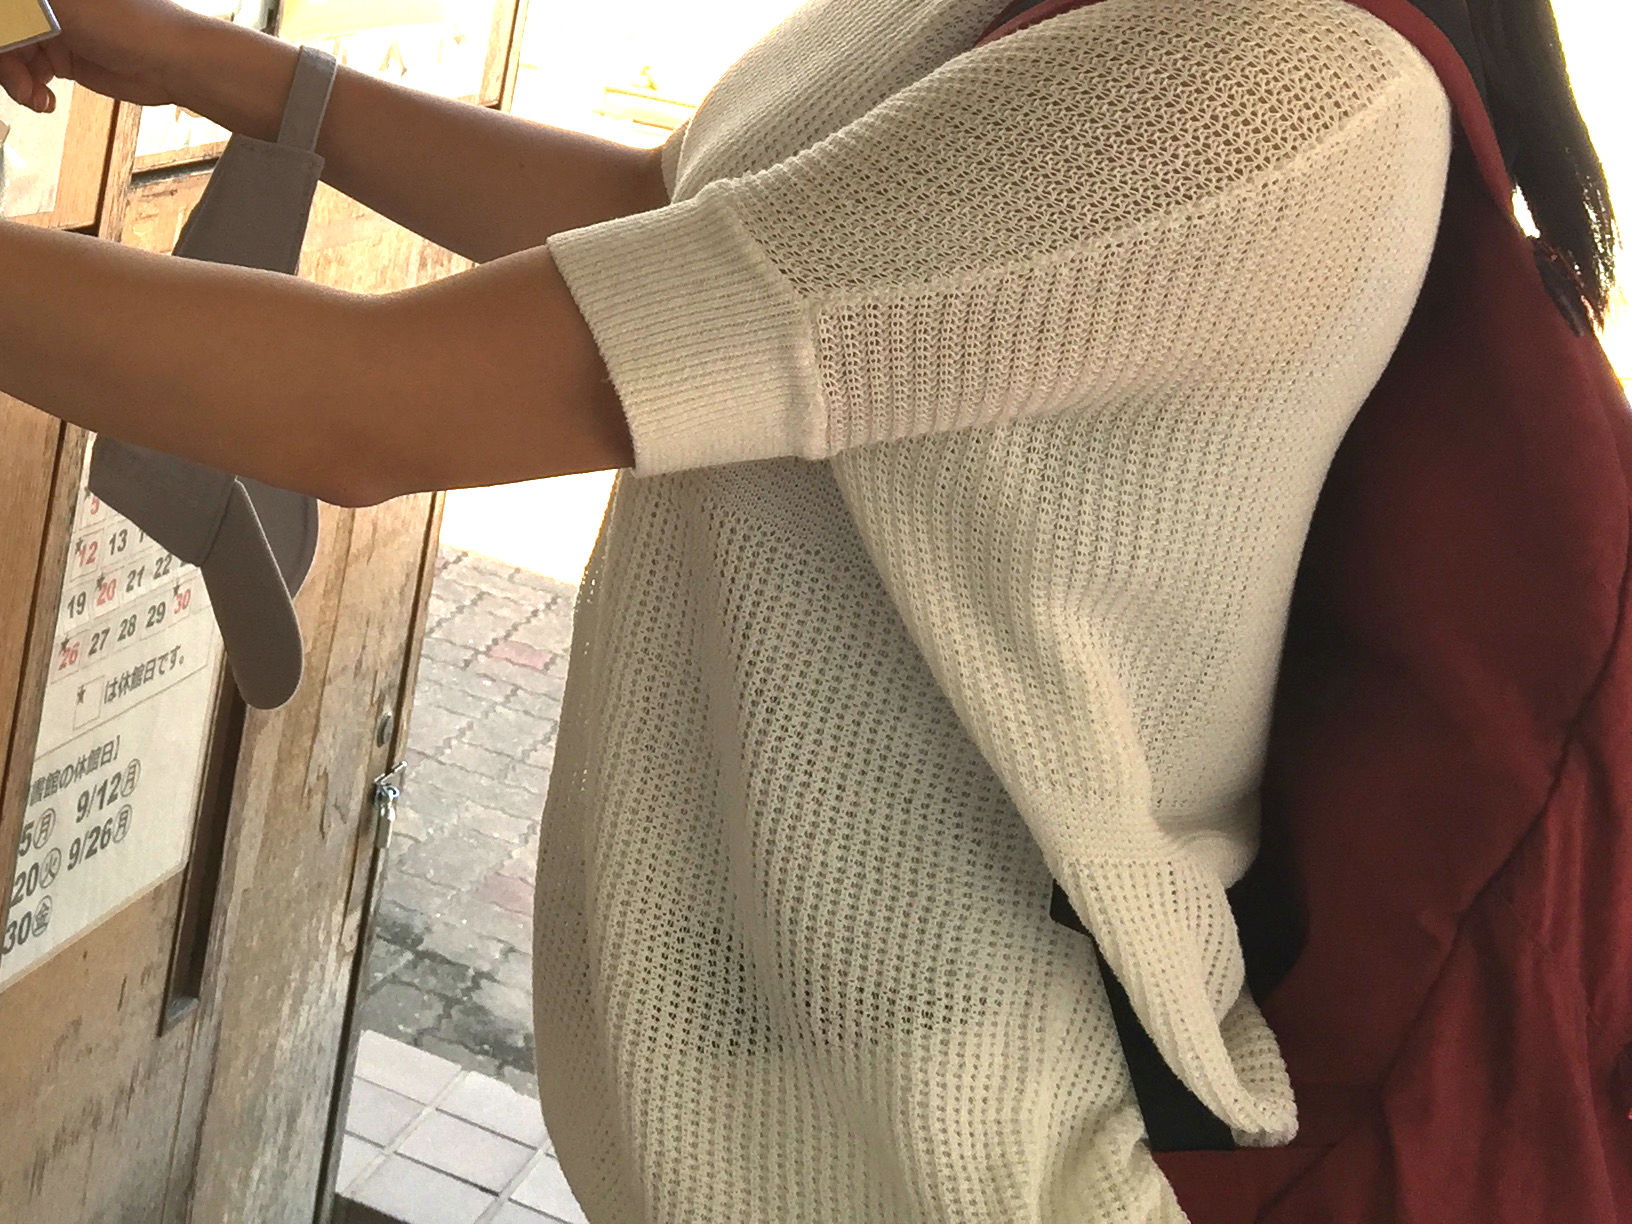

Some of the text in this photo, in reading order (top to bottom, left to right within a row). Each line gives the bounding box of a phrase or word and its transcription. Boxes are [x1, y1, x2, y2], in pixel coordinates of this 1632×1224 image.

[78, 540, 100, 568] 12
[108, 528, 129, 557] 13
[67, 591, 86, 619] 19
[95, 578, 117, 607] 20
[125, 565, 146, 594] 21
[152, 552, 174, 581] 22
[58, 587, 193, 672] 26 27 28 29 30
[104, 644, 186, 705] は休館日です。
